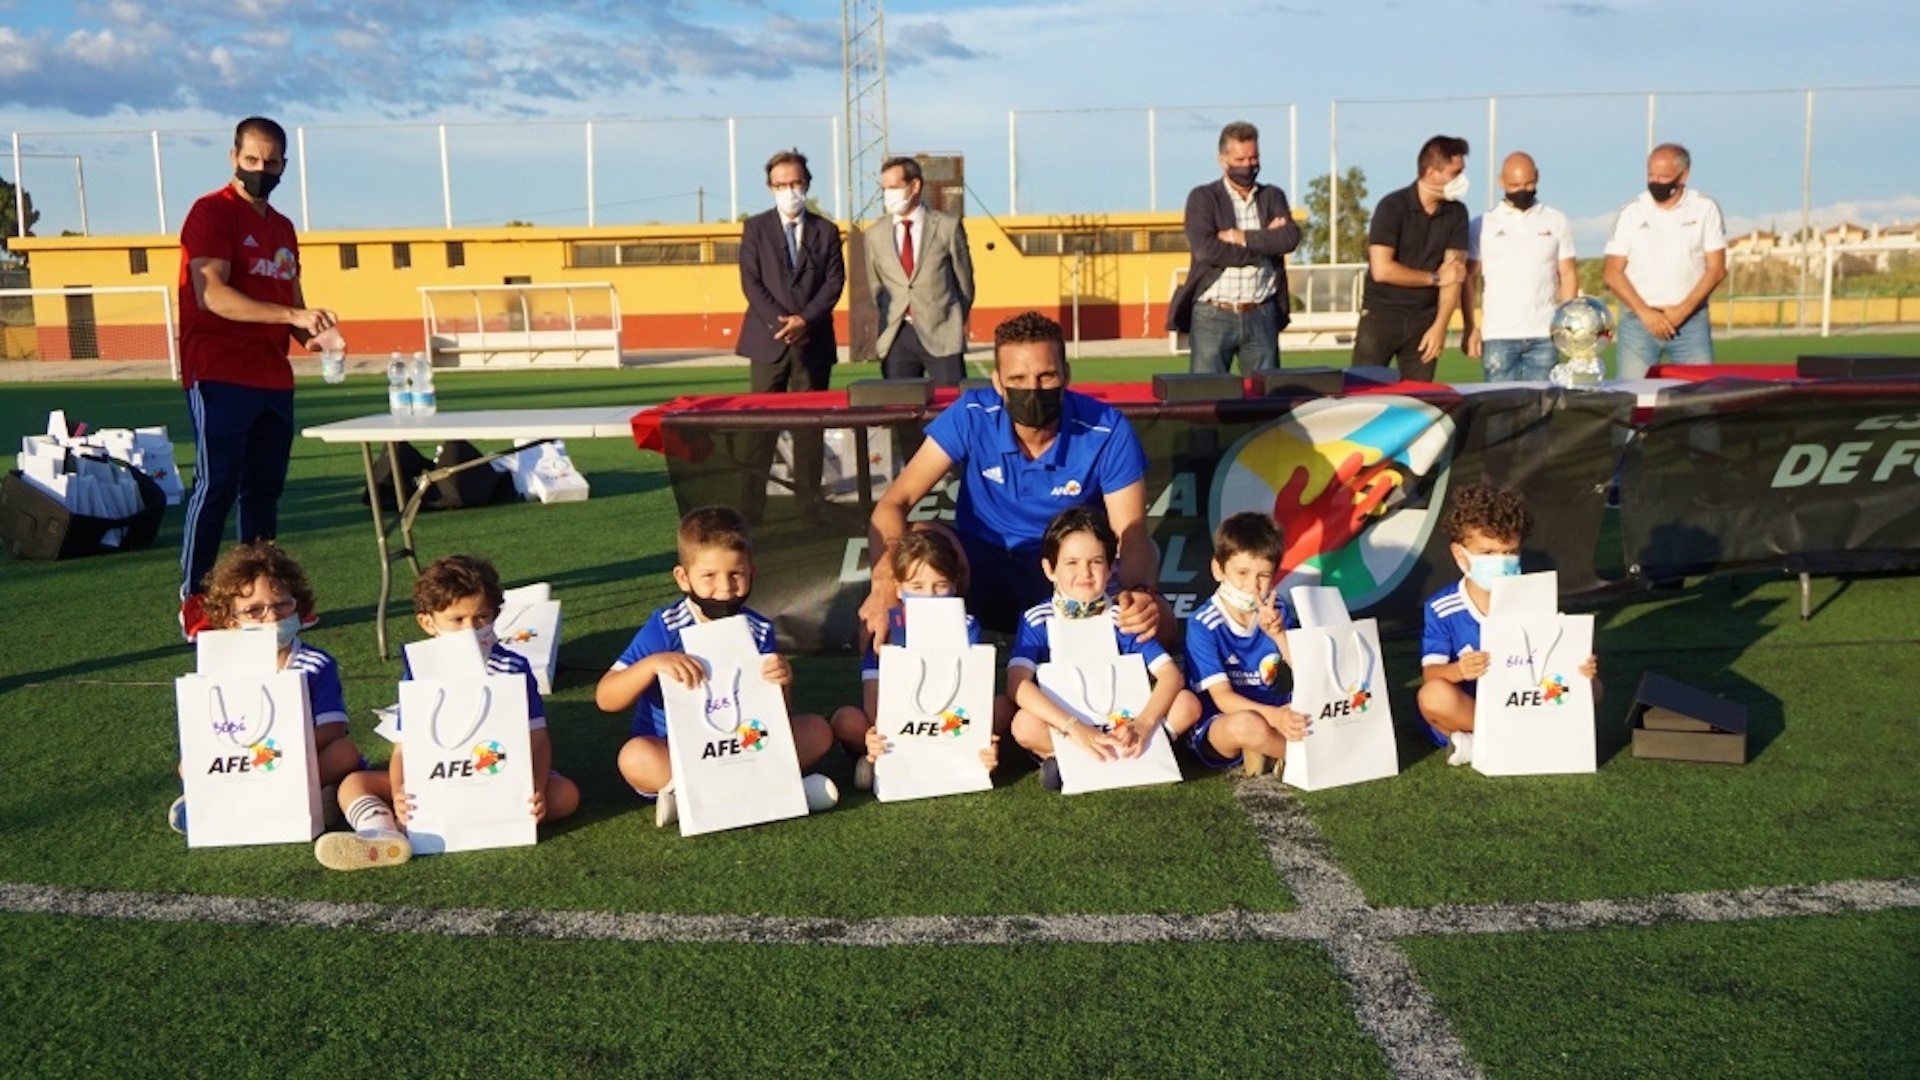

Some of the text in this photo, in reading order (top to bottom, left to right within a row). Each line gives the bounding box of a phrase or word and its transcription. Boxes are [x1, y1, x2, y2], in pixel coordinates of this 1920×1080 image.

[1770, 441, 1874, 488] DE
[1505, 690, 1542, 708] AFE
[1319, 699, 1351, 720] AFE
[898, 720, 940, 737] AFE
[701, 738, 742, 760] AFE
[207, 755, 251, 775] AFE
[429, 760, 473, 780] AFE
